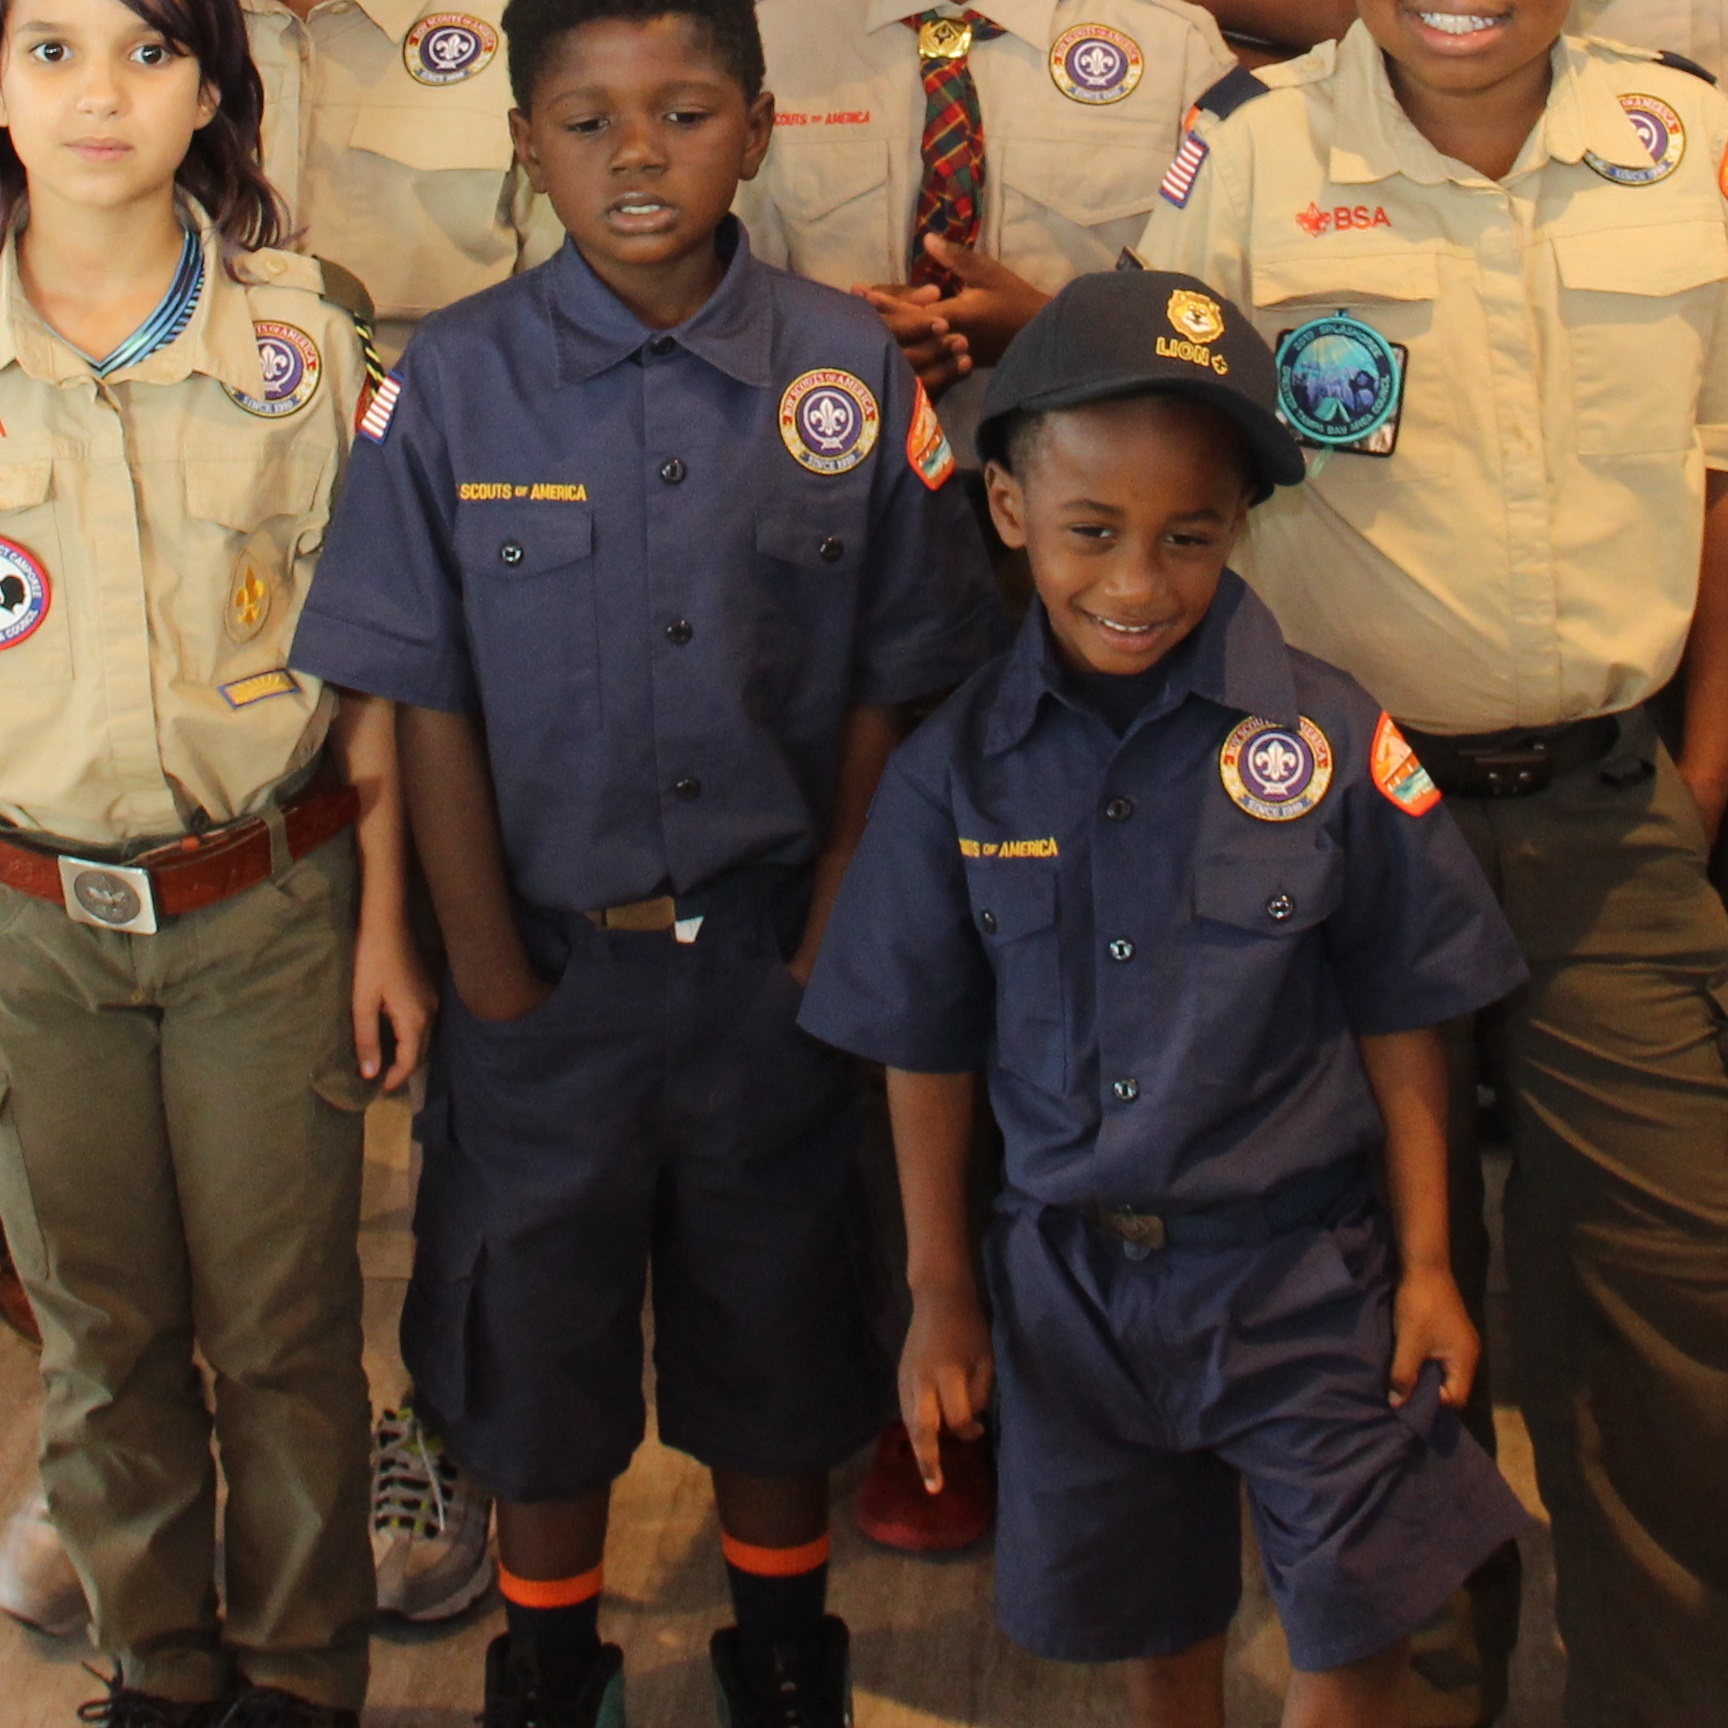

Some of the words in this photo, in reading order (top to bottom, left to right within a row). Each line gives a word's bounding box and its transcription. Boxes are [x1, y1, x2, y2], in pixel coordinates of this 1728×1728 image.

[774, 113, 807, 126] COUTS
[1333, 205, 1392, 230] BSA
[1155, 336, 1210, 367] LION
[459, 482, 512, 500] SCOUTS
[514, 485, 529, 497] OF
[530, 482, 588, 502] AMERICA
[999, 837, 1059, 859] AMERICA
